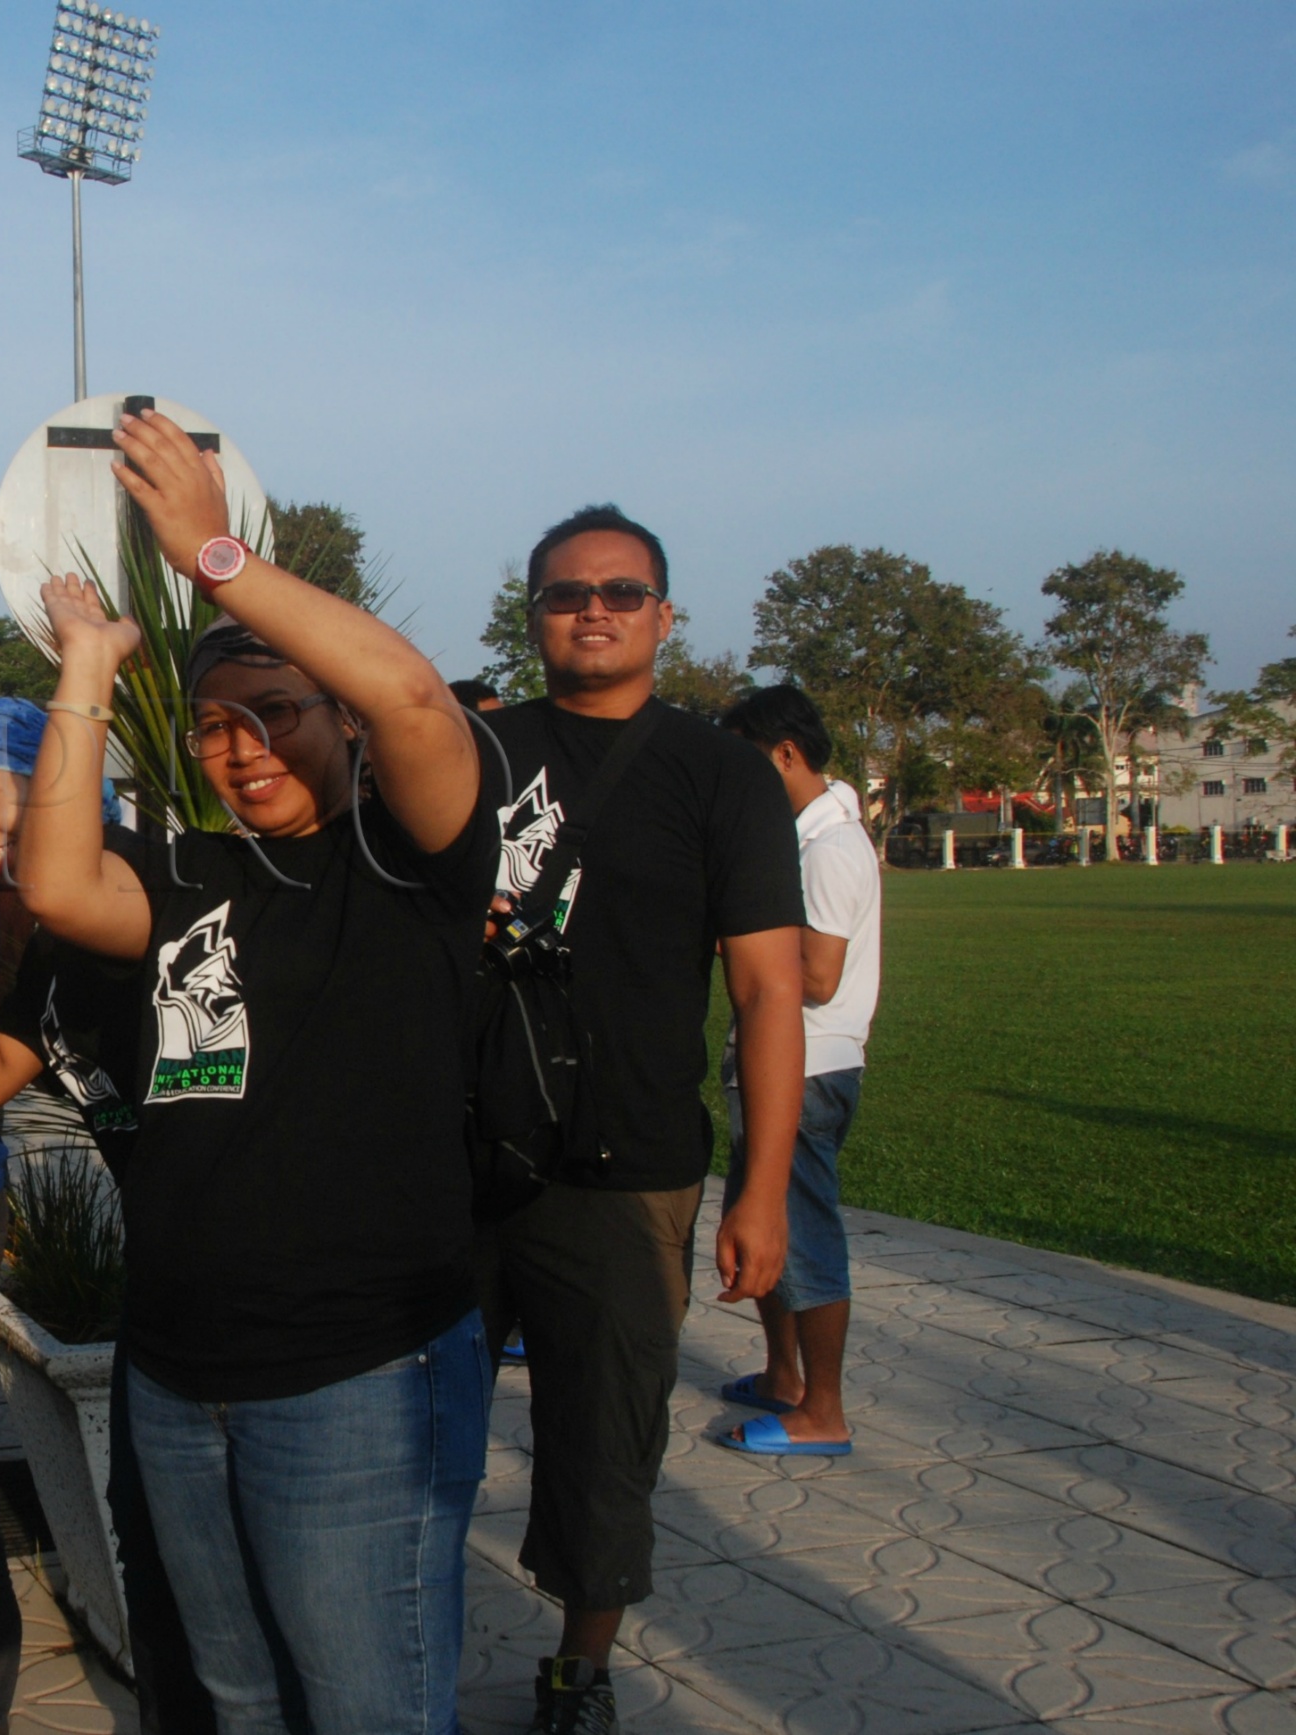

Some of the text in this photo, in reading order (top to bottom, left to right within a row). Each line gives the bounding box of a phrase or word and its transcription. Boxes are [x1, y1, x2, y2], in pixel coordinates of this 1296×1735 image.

[157, 1048, 245, 1074] MASIAN
[152, 1075, 242, 1094] OTDOOR
[154, 1064, 243, 1085] INTATIONAL
[207, 1084, 241, 1093] CONFERENCE
